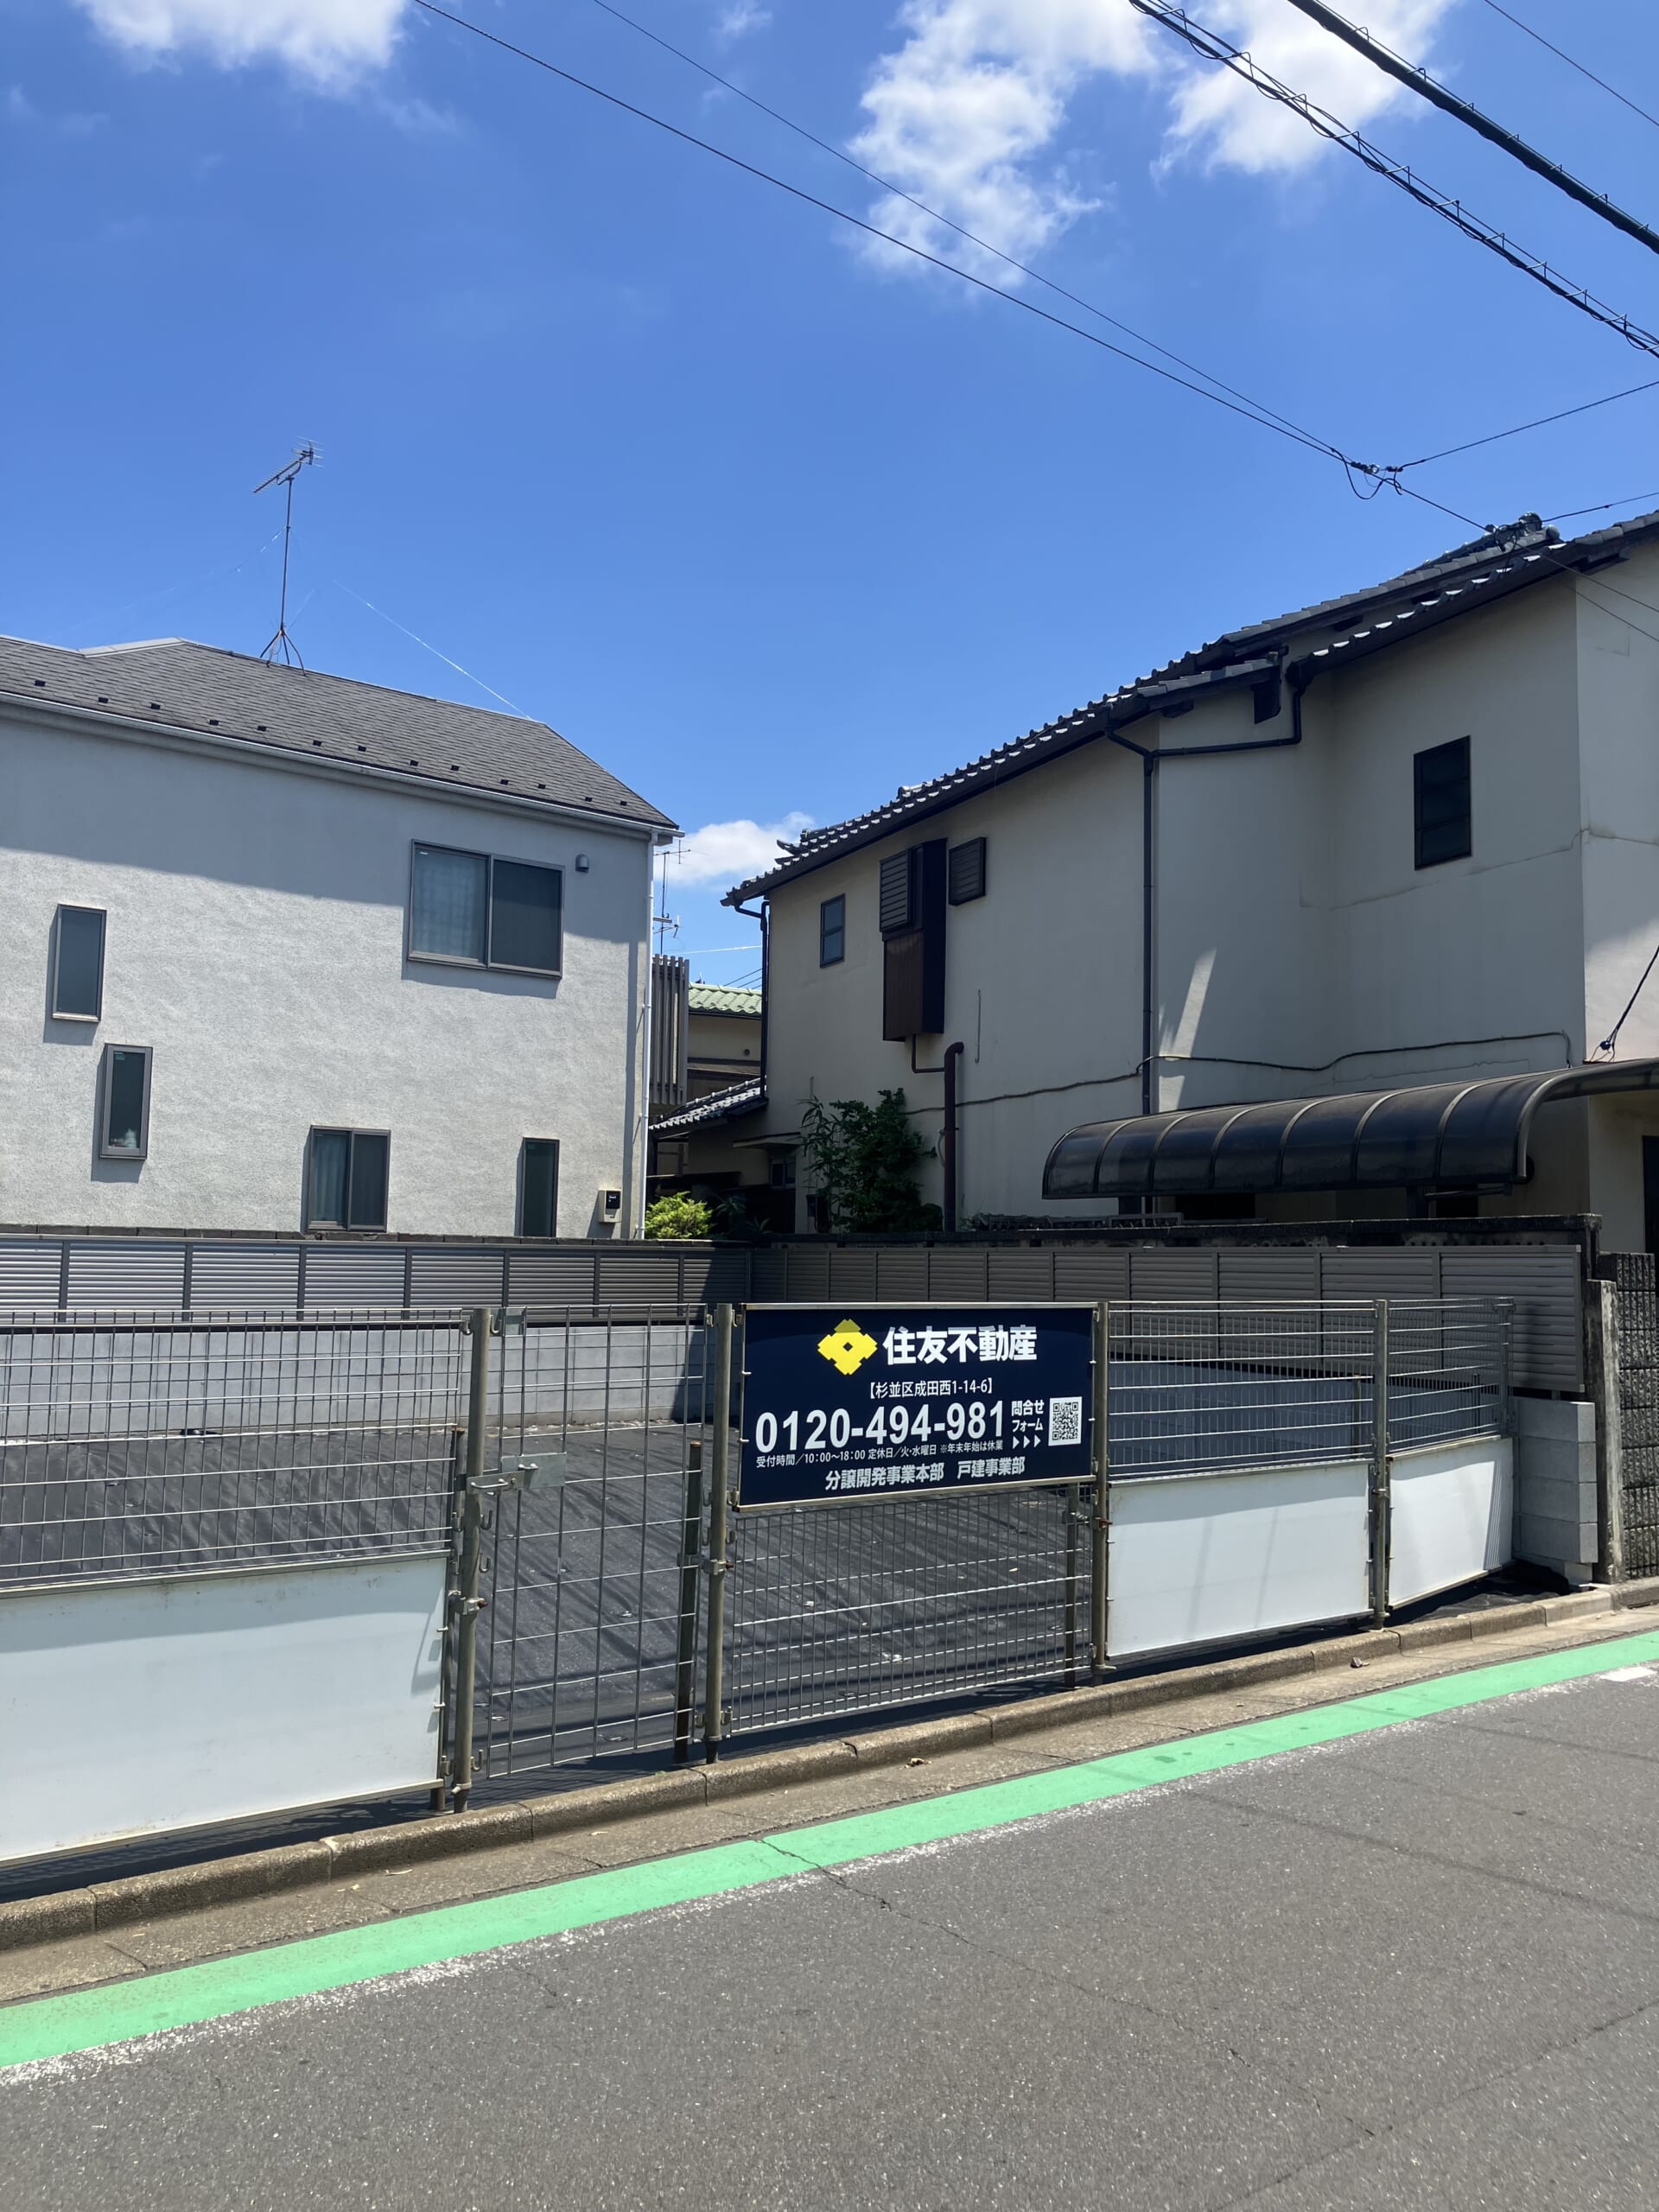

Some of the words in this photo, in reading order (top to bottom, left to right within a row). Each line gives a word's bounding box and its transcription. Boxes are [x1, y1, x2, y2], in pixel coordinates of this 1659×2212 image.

[883, 1325, 1038, 1365] 住友不動産
[1011, 1400, 1044, 1416] 問合せ
[1012, 1419, 1043, 1432] フォーム
[755, 1400, 1003, 1453] 0120-494-981
[825, 1461, 944, 1491] 分譲開発事業本部
[957, 1456, 1026, 1479] 戸建事業部
